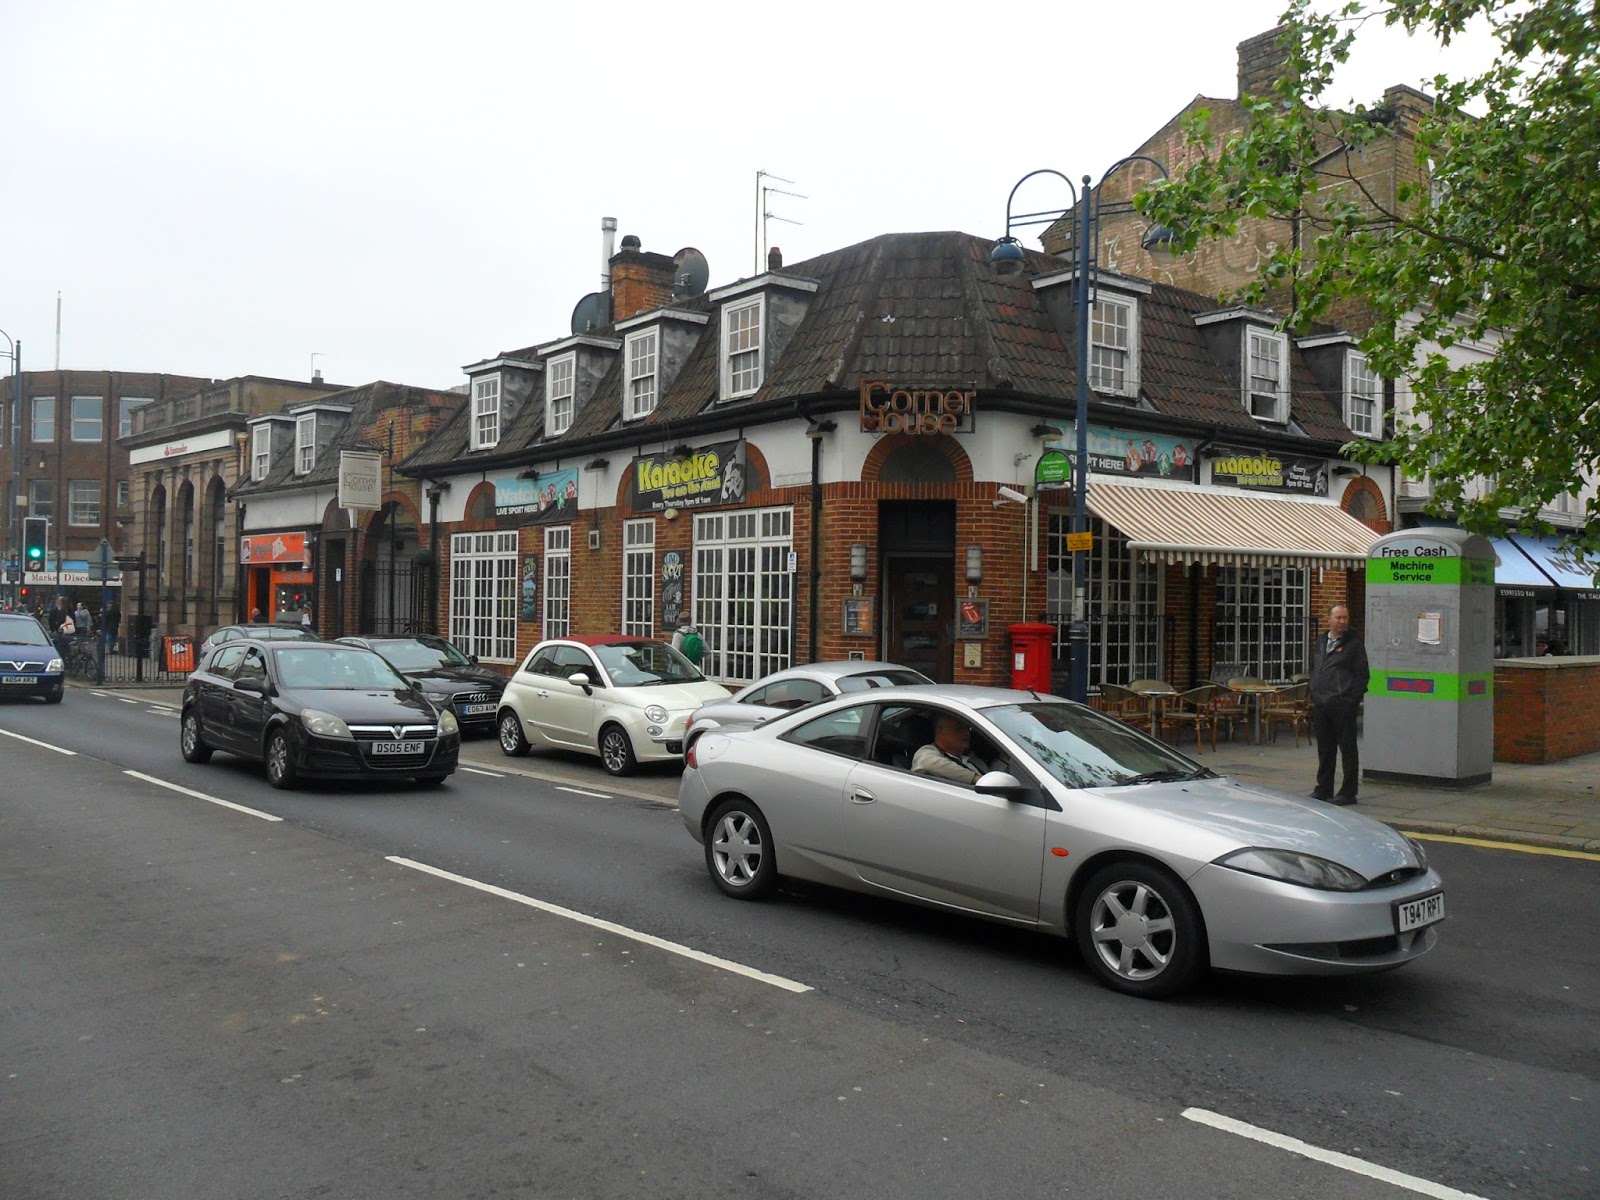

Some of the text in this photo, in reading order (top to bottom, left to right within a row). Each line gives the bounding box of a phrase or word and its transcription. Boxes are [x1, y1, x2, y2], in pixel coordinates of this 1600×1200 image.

[865, 381, 977, 415] Corner
[860, 411, 958, 435] House
[1099, 457, 1125, 471] HERE!
[1214, 452, 1282, 477] Karaoke
[638, 451, 719, 494] Karaoke
[344, 474, 377, 485] Corner
[664, 498, 684, 508] Thursday
[496, 507, 508, 516] LIVE
[508, 506, 523, 515] SPORT
[1382, 545, 1448, 558] Free Cash
[1390, 560, 1434, 571] Machine
[1392, 572, 1432, 582] Service
[376, 742, 422, 753] DS05 ENF
[1403, 901, 1426, 926] T947
